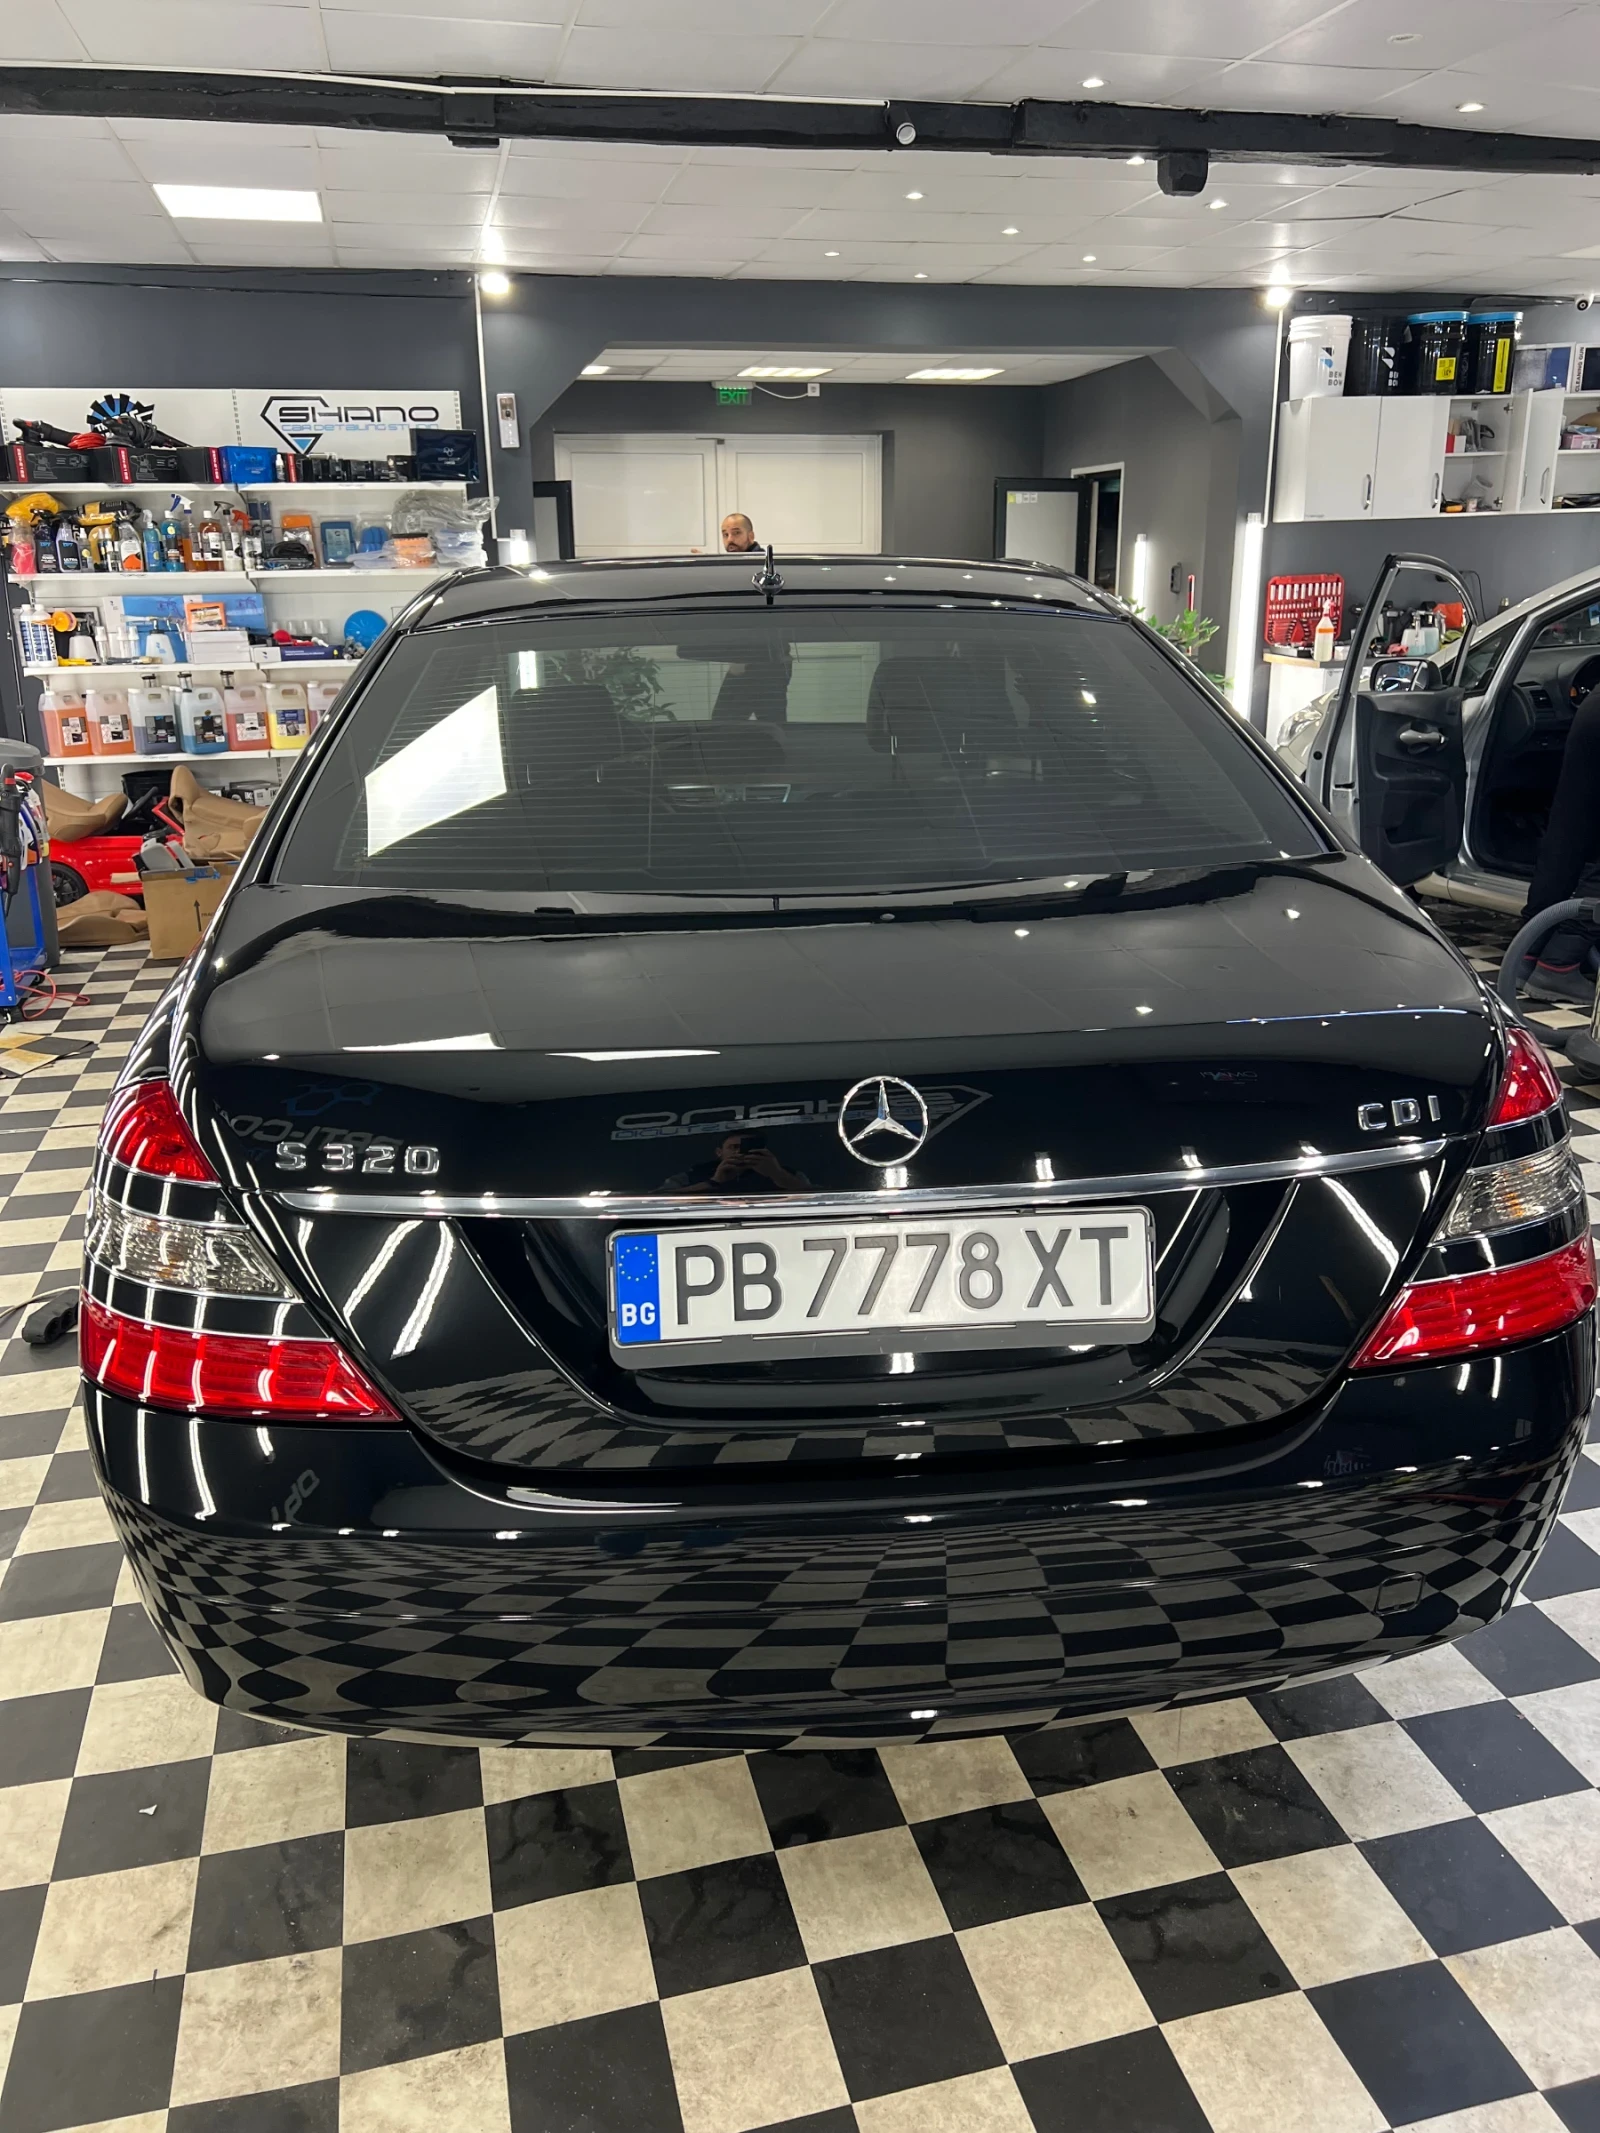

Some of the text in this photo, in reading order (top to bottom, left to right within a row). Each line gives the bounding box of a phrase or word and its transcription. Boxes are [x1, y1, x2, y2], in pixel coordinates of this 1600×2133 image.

[1575, 362, 1583, 392] CLEANING
[719, 391, 749, 404] EXIT
[279, 406, 439, 423] SHANO
[314, 423, 386, 431] DETAILING
[1358, 1095, 1441, 1130] CDI
[275, 1141, 440, 1174] S 320
[675, 1227, 1130, 1325] PB 7778 XT
[621, 1301, 656, 1327] BG
